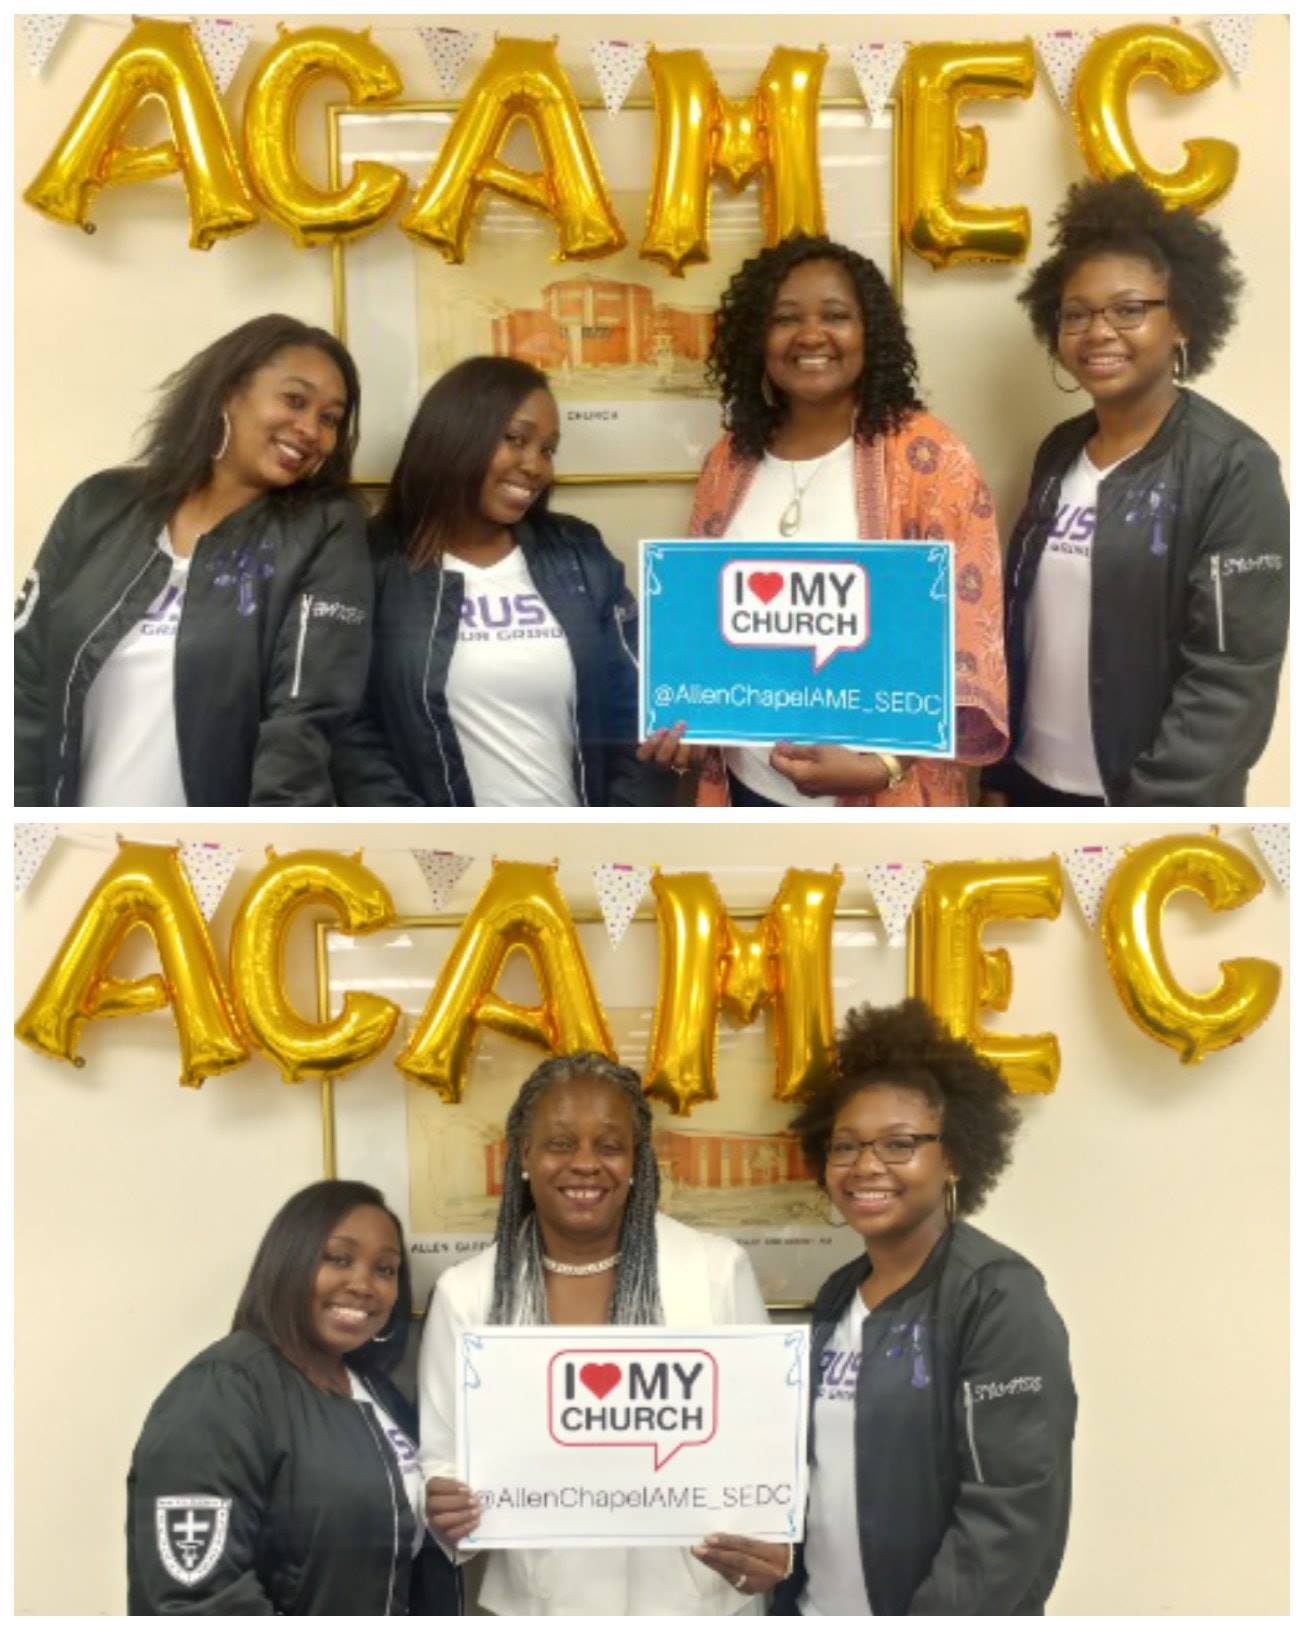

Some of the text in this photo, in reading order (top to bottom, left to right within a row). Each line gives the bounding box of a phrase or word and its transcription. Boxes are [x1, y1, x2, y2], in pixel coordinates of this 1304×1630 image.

[23, 15, 1240, 273] ACAMEC
[735, 571, 856, 608] I MY
[731, 609, 858, 636] CHURCH
[654, 683, 943, 716] @AllenChapelAME_SEDC
[14, 826, 1282, 1118] ACAMEC
[565, 1362, 704, 1400] I MY
[560, 1406, 703, 1431] CHURCH
